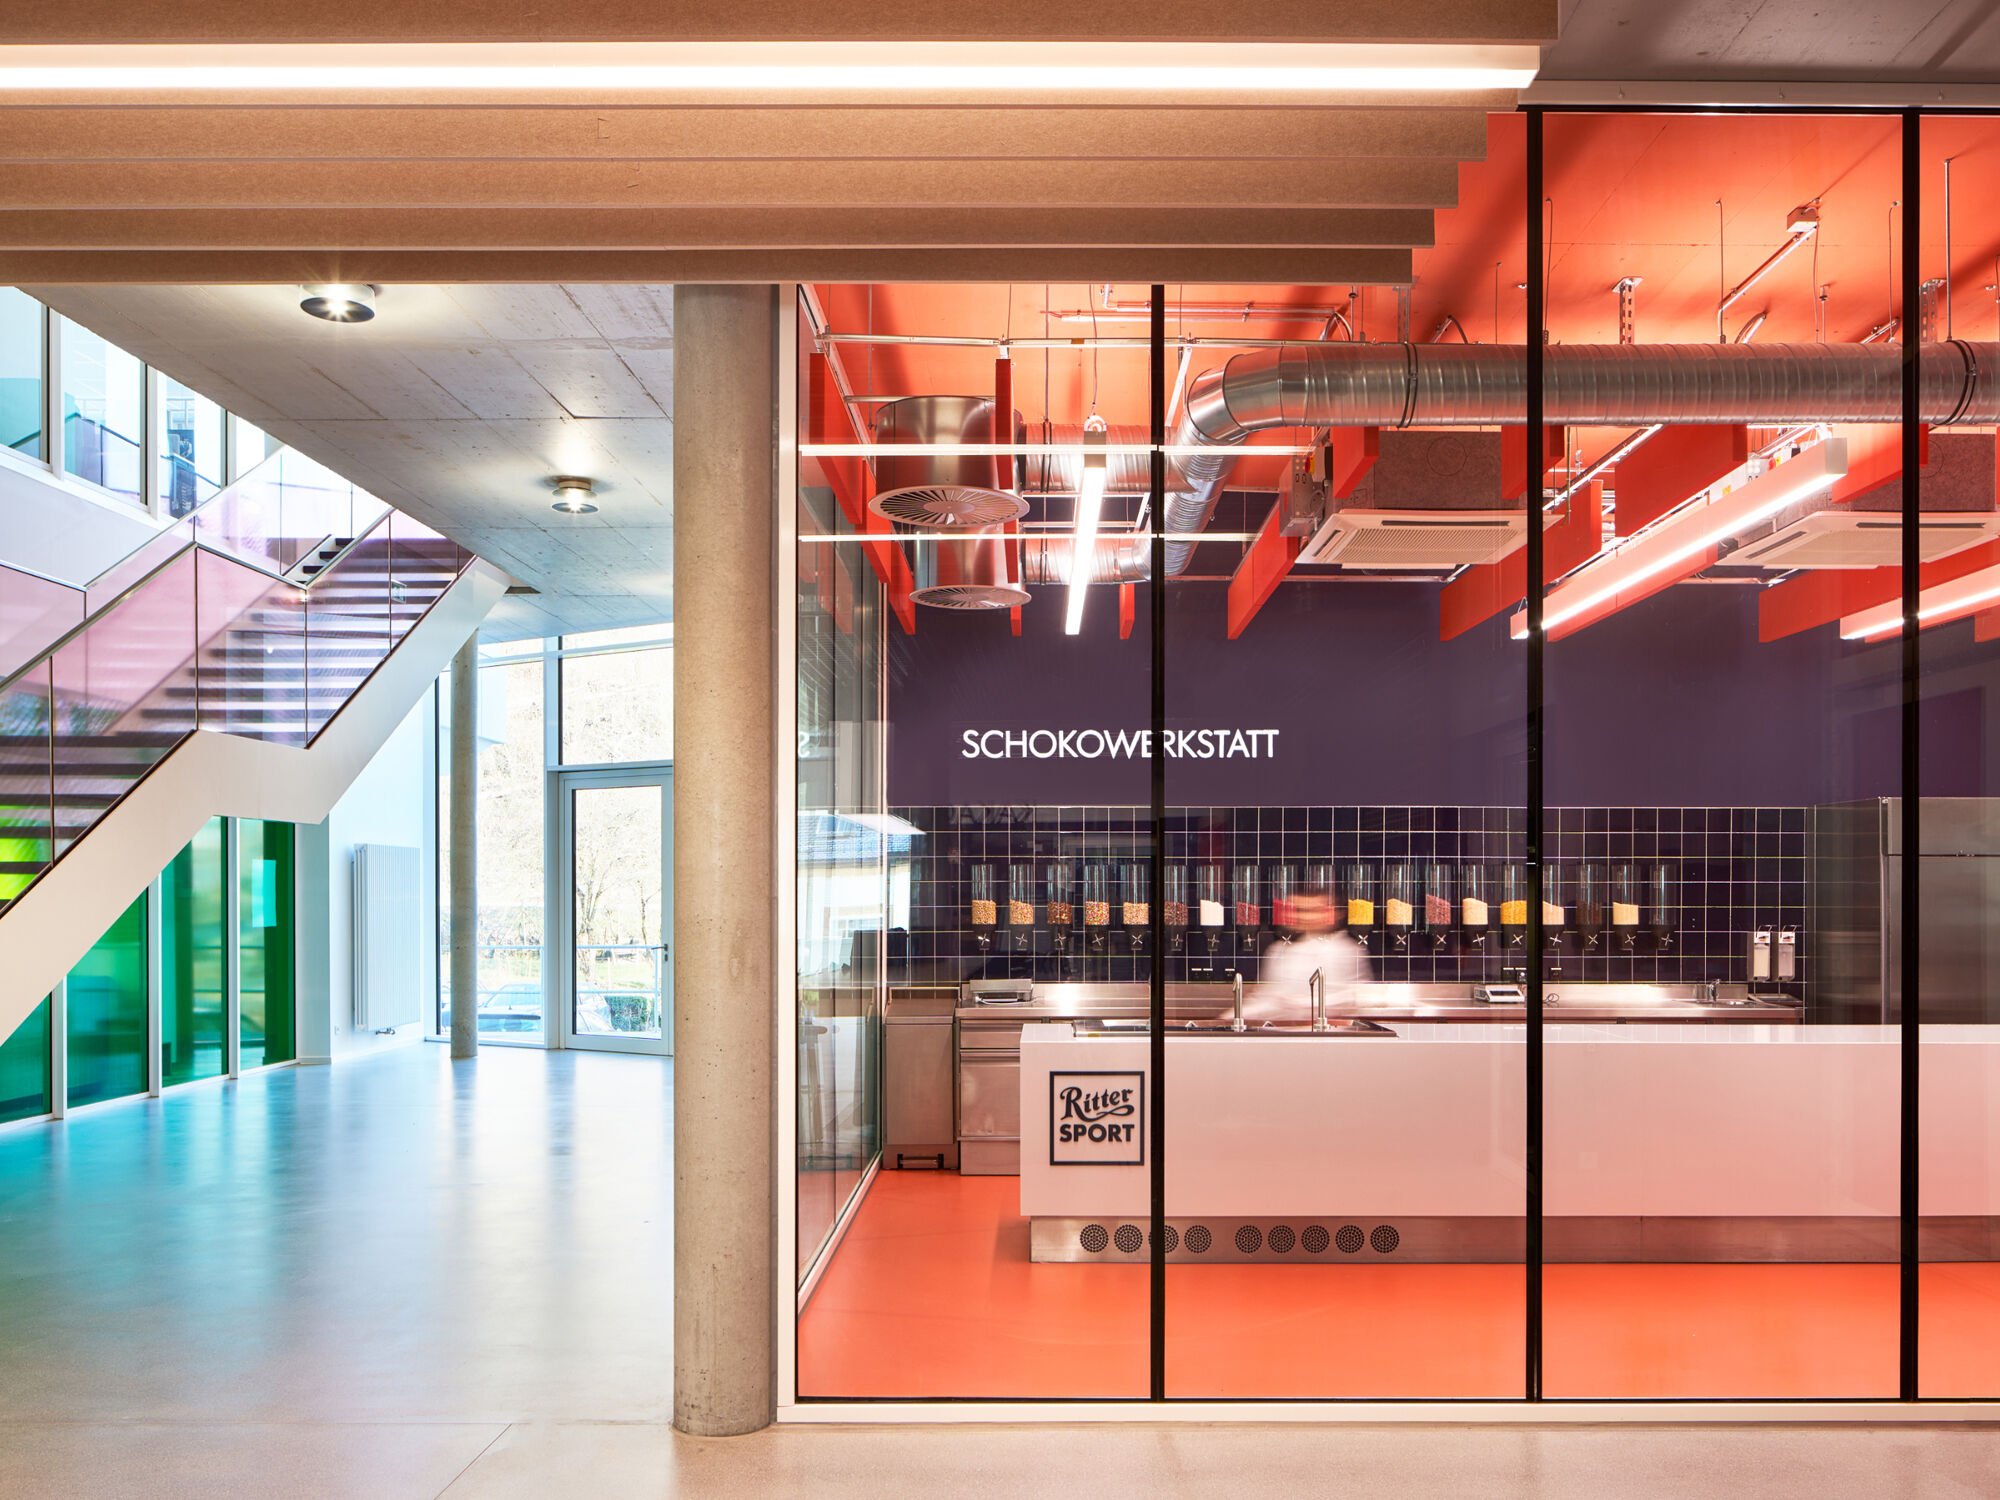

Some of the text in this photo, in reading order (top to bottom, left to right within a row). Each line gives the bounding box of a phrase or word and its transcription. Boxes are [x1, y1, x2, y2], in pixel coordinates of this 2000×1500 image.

[961, 729, 1280, 759] SCHOKOWERKSTATT
[1059, 1086, 1135, 1122] Ritter
[1059, 1123, 1135, 1143] SPORT
